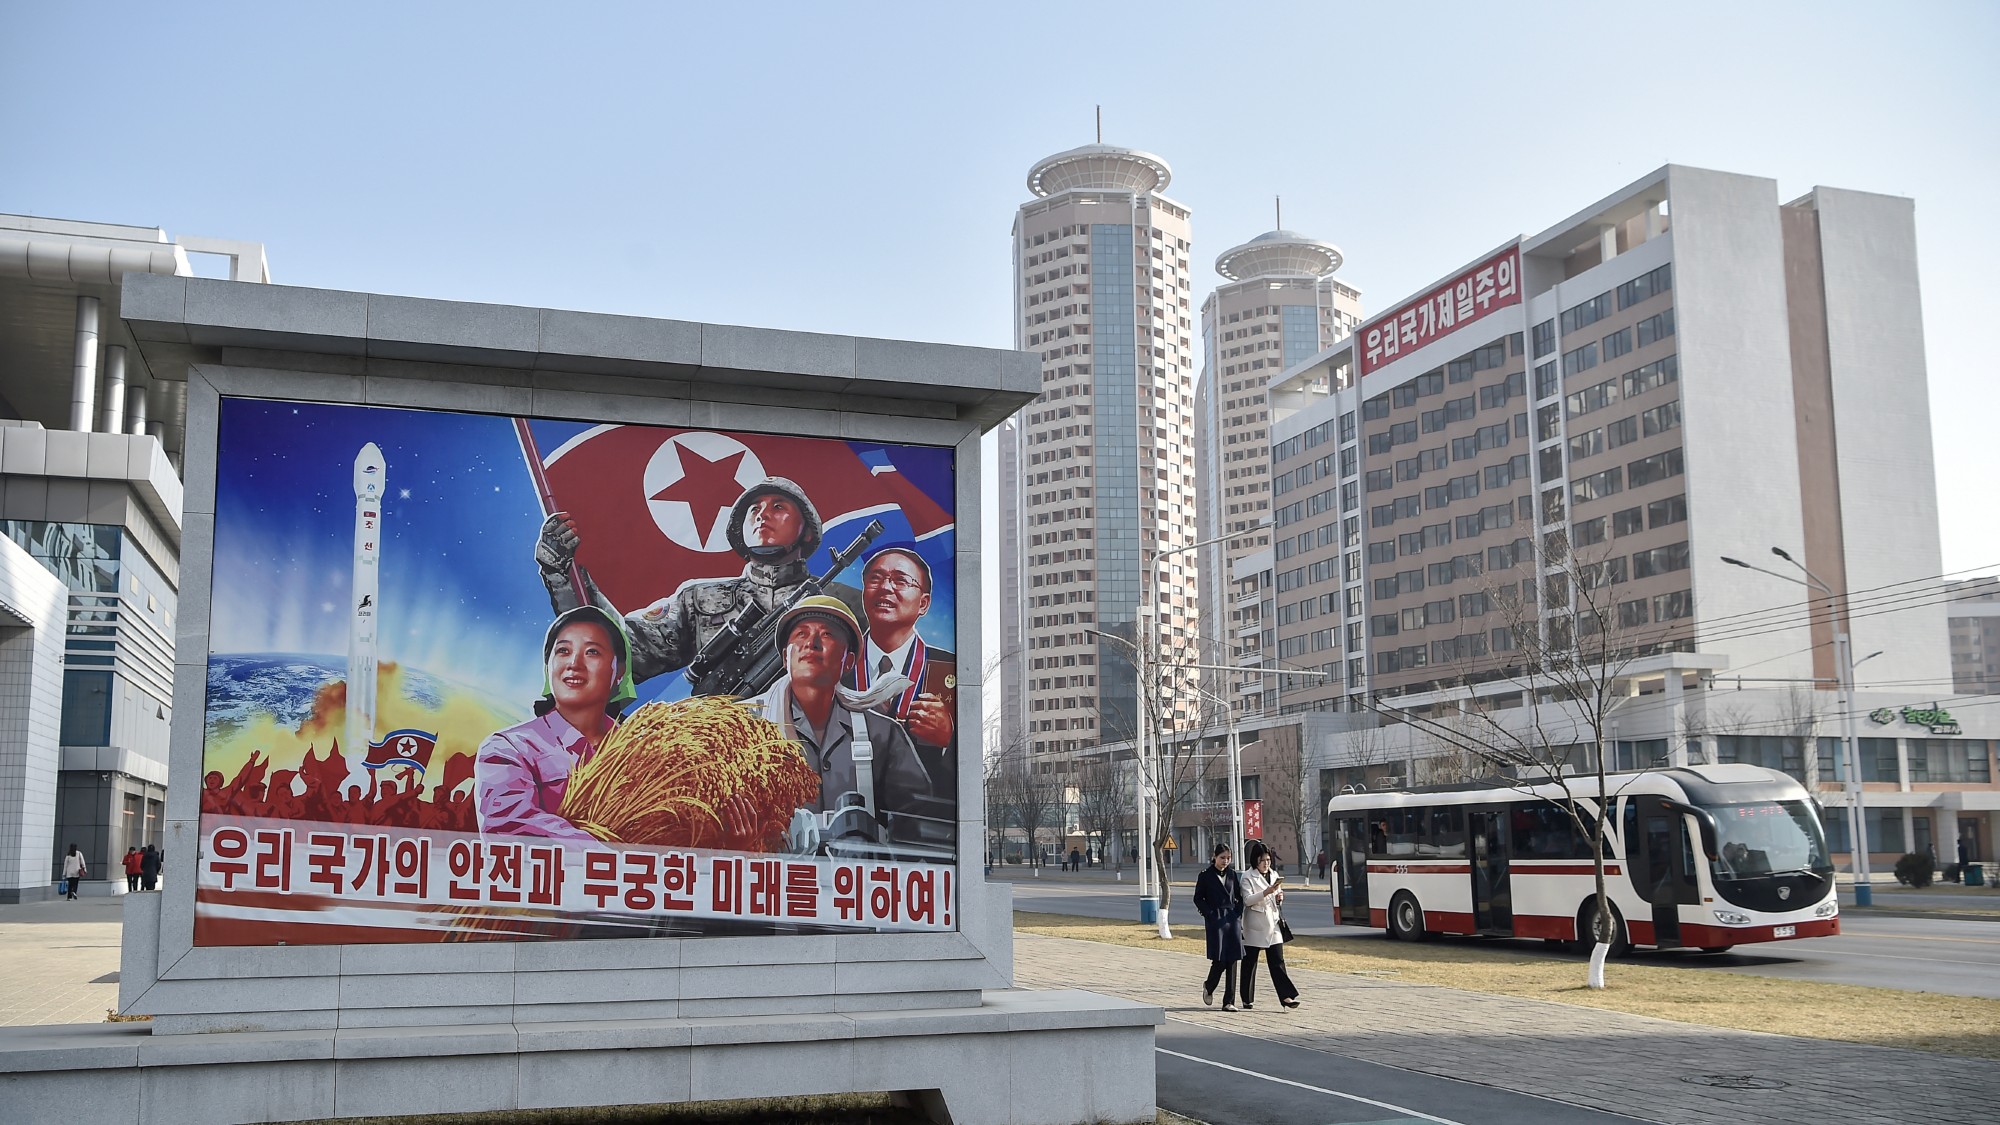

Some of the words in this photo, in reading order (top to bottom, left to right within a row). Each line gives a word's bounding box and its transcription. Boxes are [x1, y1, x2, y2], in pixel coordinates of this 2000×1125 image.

[364, 520, 373, 550] 조선
[209, 829, 292, 892] 우리
[308, 834, 428, 899] 국가의
[447, 841, 565, 906] 안전과
[583, 852, 697, 911] 무궁한
[711, 857, 820, 918] 미래를
[833, 865, 951, 926] 위하여!
[1395, 864, 1408, 874] 555
